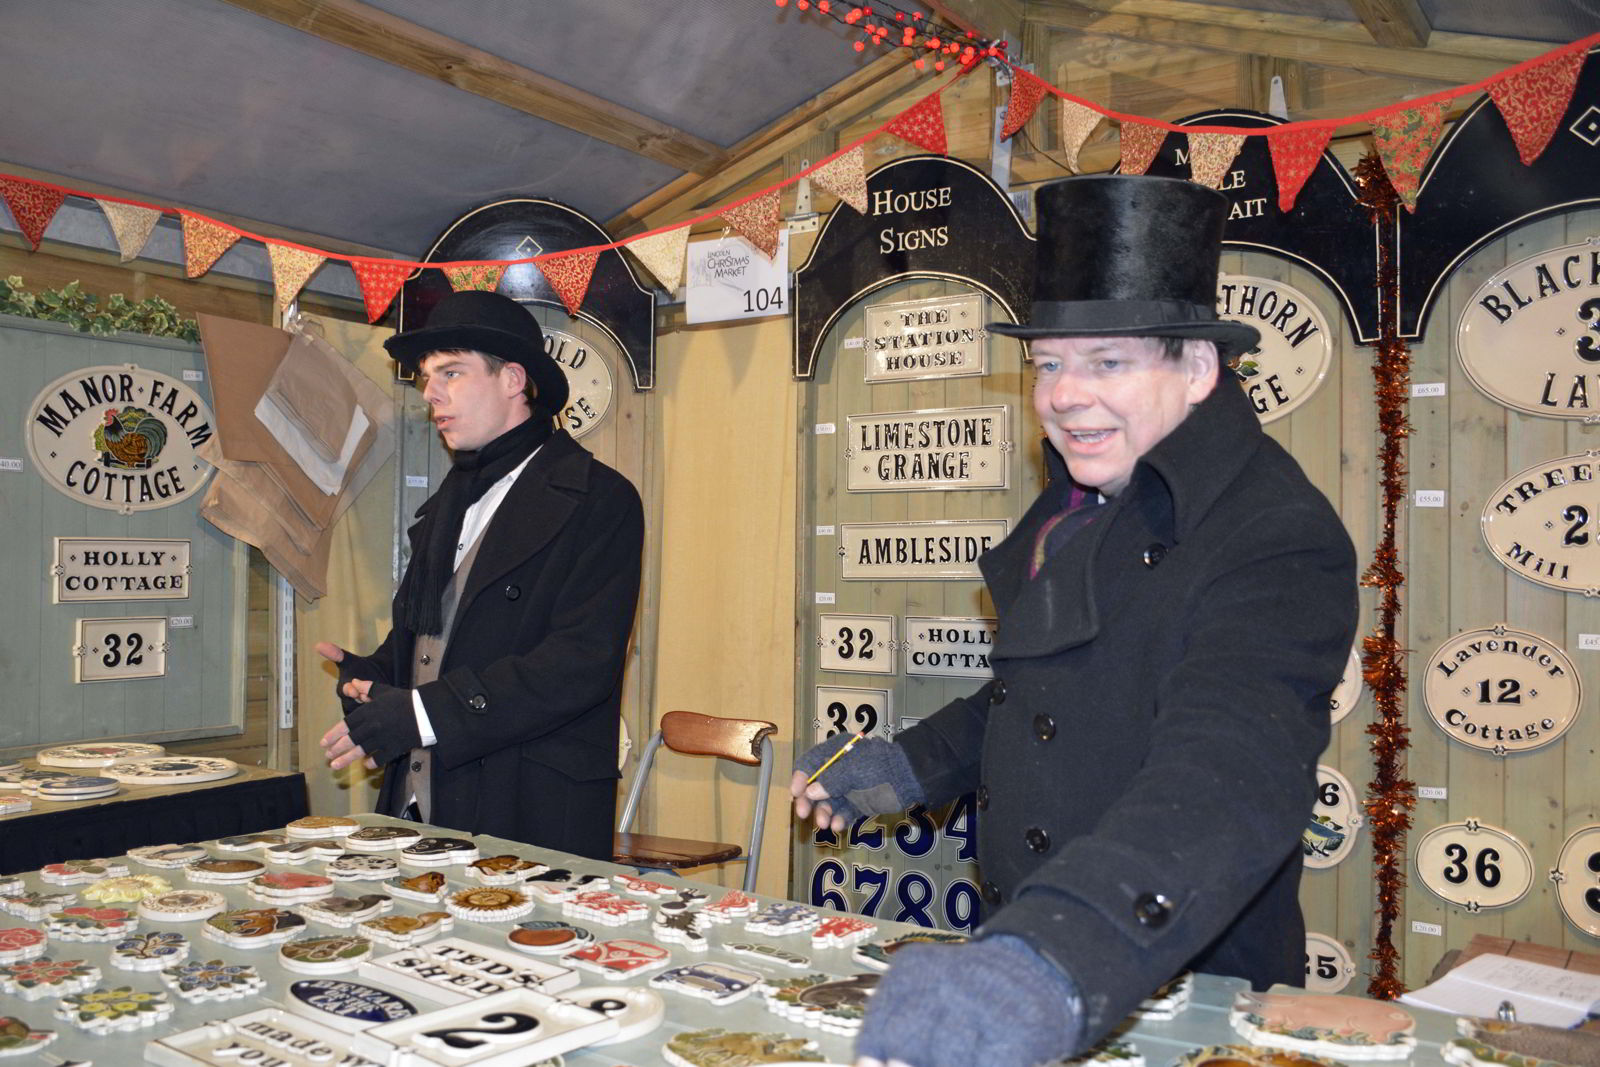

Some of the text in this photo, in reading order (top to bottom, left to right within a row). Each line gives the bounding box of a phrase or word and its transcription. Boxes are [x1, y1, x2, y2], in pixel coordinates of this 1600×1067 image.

[1228, 198, 1267, 220] AIT
[707, 256, 750, 270] CHRISTMAS
[708, 250, 731, 259] LINCOLN
[714, 266, 746, 279] MARKET
[743, 286, 784, 313] 104
[900, 310, 949, 326] THE
[1222, 284, 1319, 348] THORN
[874, 328, 975, 350] STATION
[886, 352, 963, 371] HOUSE
[1540, 372, 1600, 408] LA
[37, 374, 213, 450] MANOR FARM
[860, 418, 992, 451] LIMESTONE
[66, 460, 185, 502] COTTAGE
[878, 452, 970, 481] GRANGE
[1496, 463, 1600, 514] TREE
[1563, 505, 1594, 546] 2
[84, 551, 166, 566] HOLLY
[859, 536, 992, 565] AMBLESIDE
[1506, 542, 1569, 580] Mill
[65, 575, 183, 590] COTTAGE
[103, 633, 143, 667] 32
[838, 627, 874, 659] 32
[928, 628, 996, 644] HOLL
[912, 652, 990, 668] COTTA
[1436, 639, 1564, 677] Lavender
[1478, 679, 1521, 704] 12
[1445, 709, 1554, 741] Cottage
[1444, 843, 1501, 888] 36
[393, 958, 504, 994] SHED
[242, 1021, 333, 1055] made
